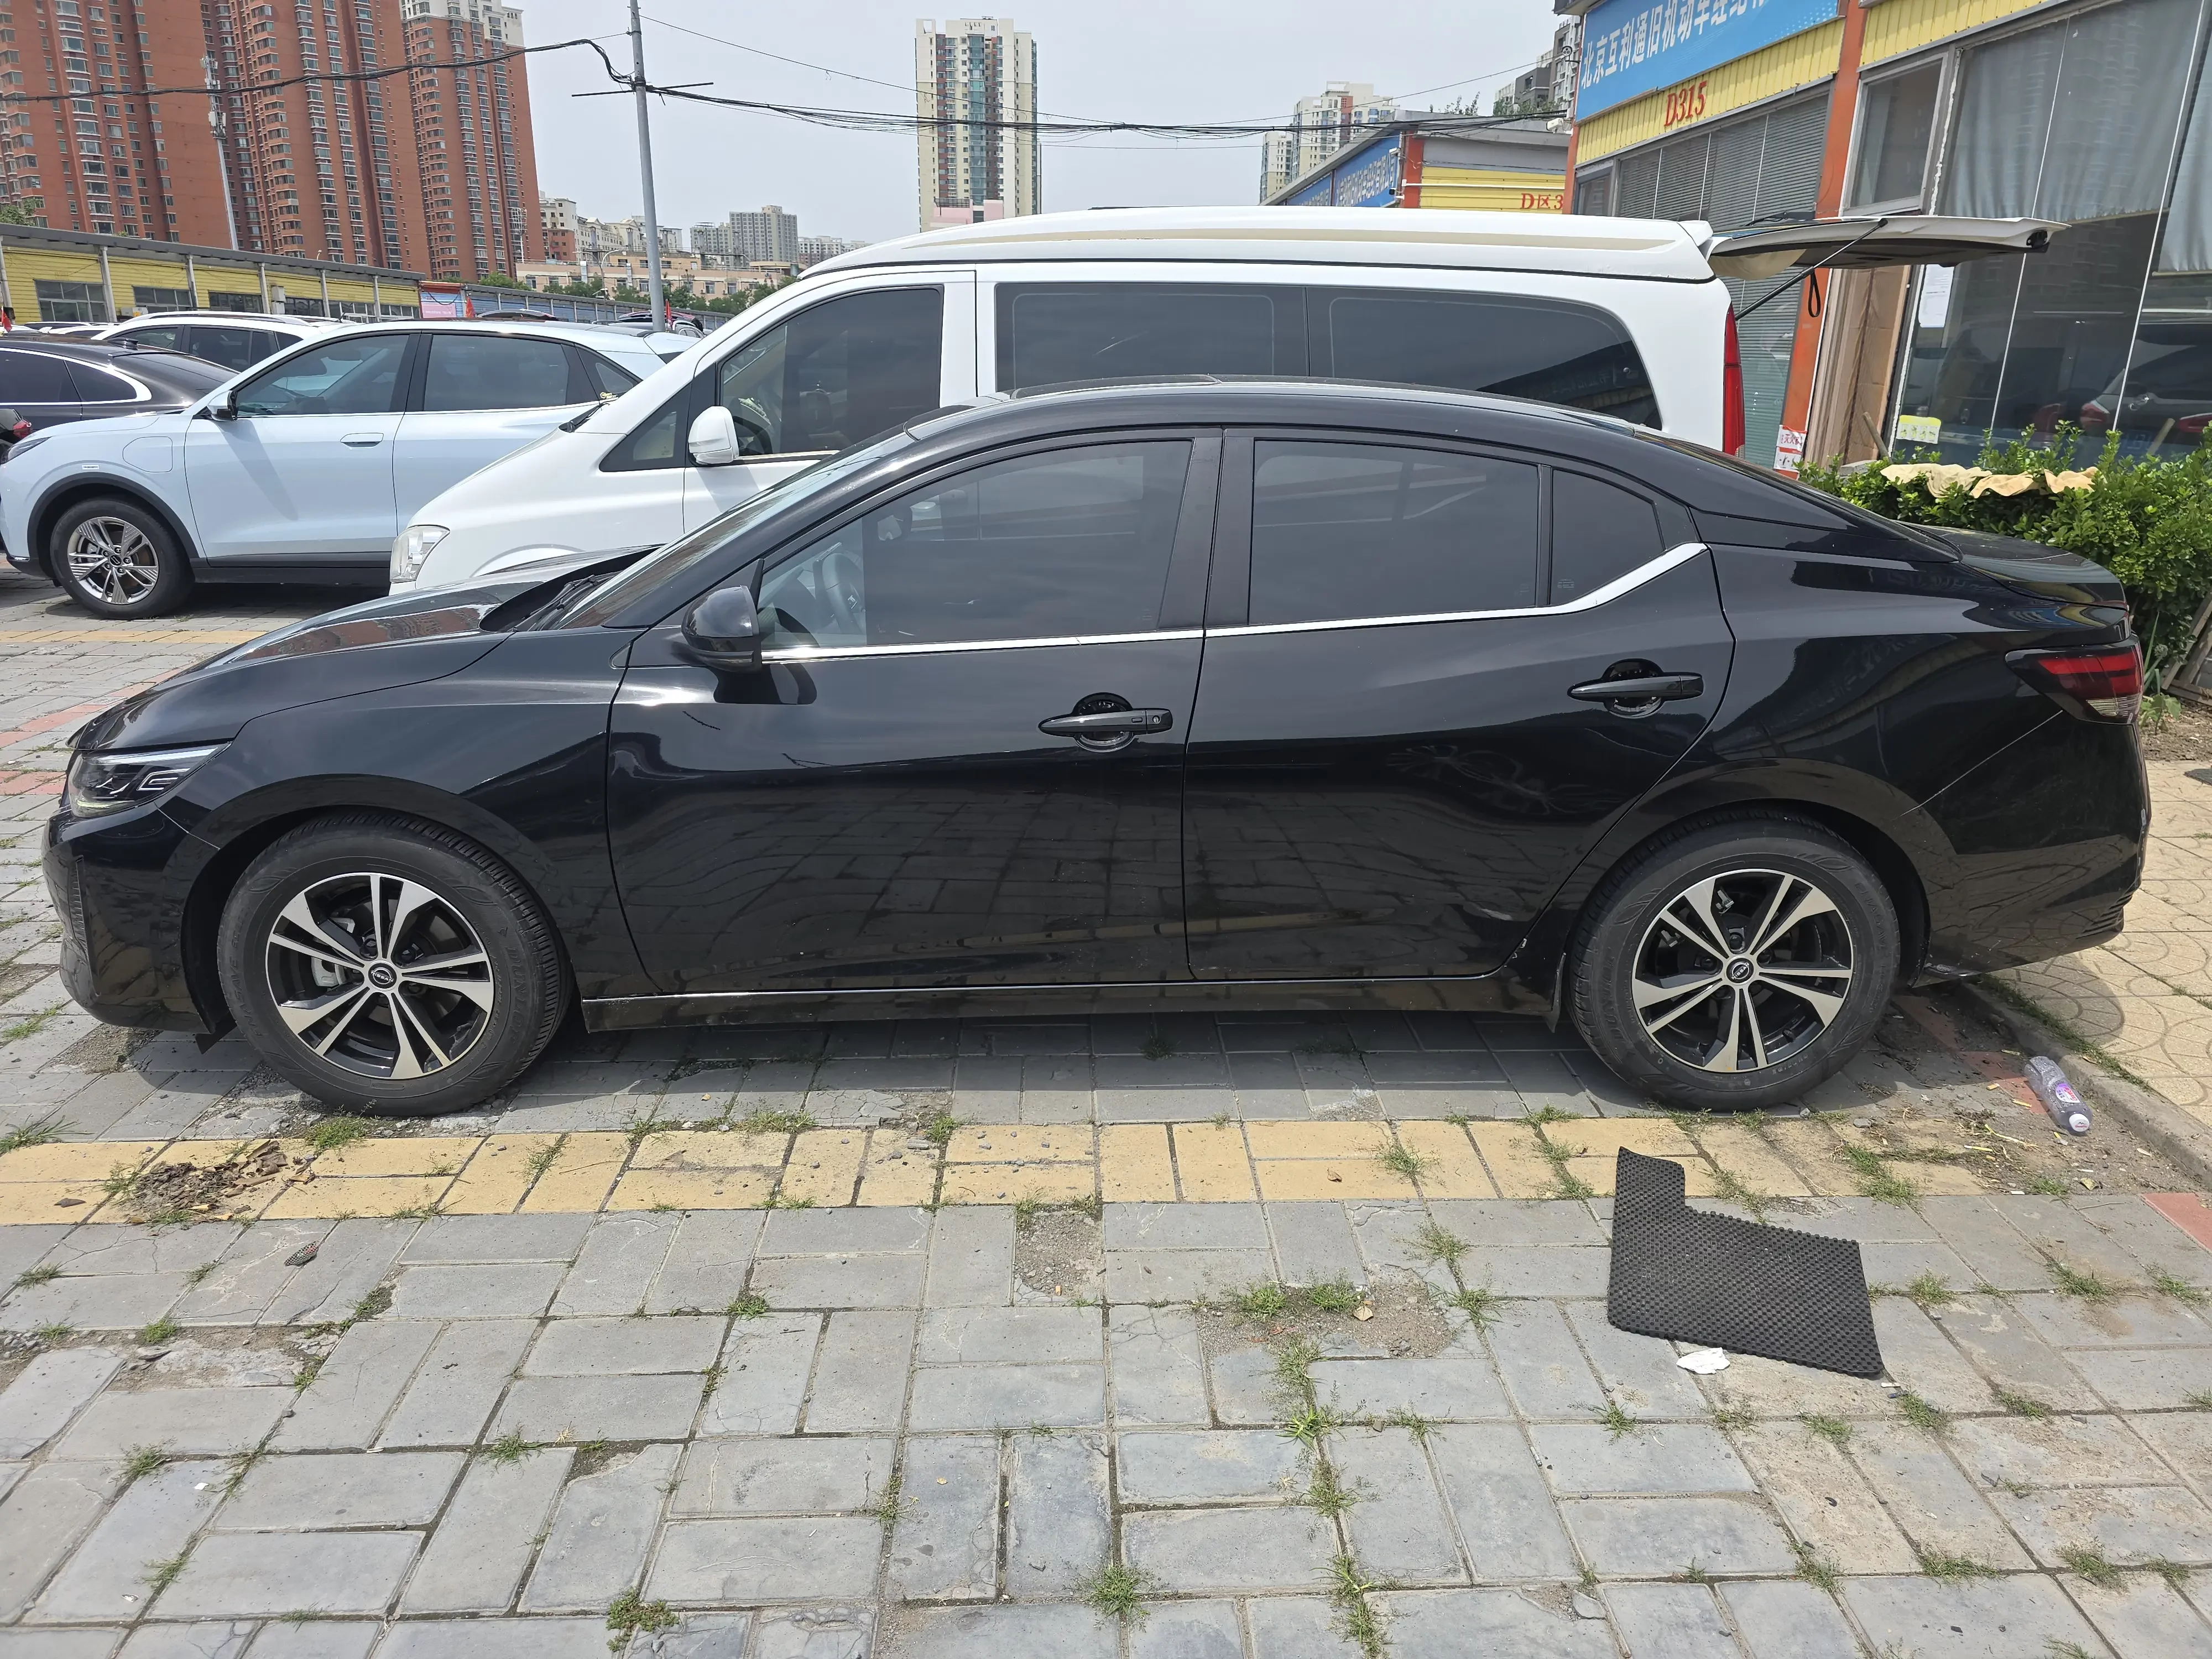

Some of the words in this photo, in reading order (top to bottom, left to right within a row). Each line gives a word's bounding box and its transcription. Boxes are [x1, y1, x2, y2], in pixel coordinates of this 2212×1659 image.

[1664, 80, 1707, 126] D315
[371, 970, 394, 982] NISSAN
[1731, 962, 1749, 979] NISSAN
